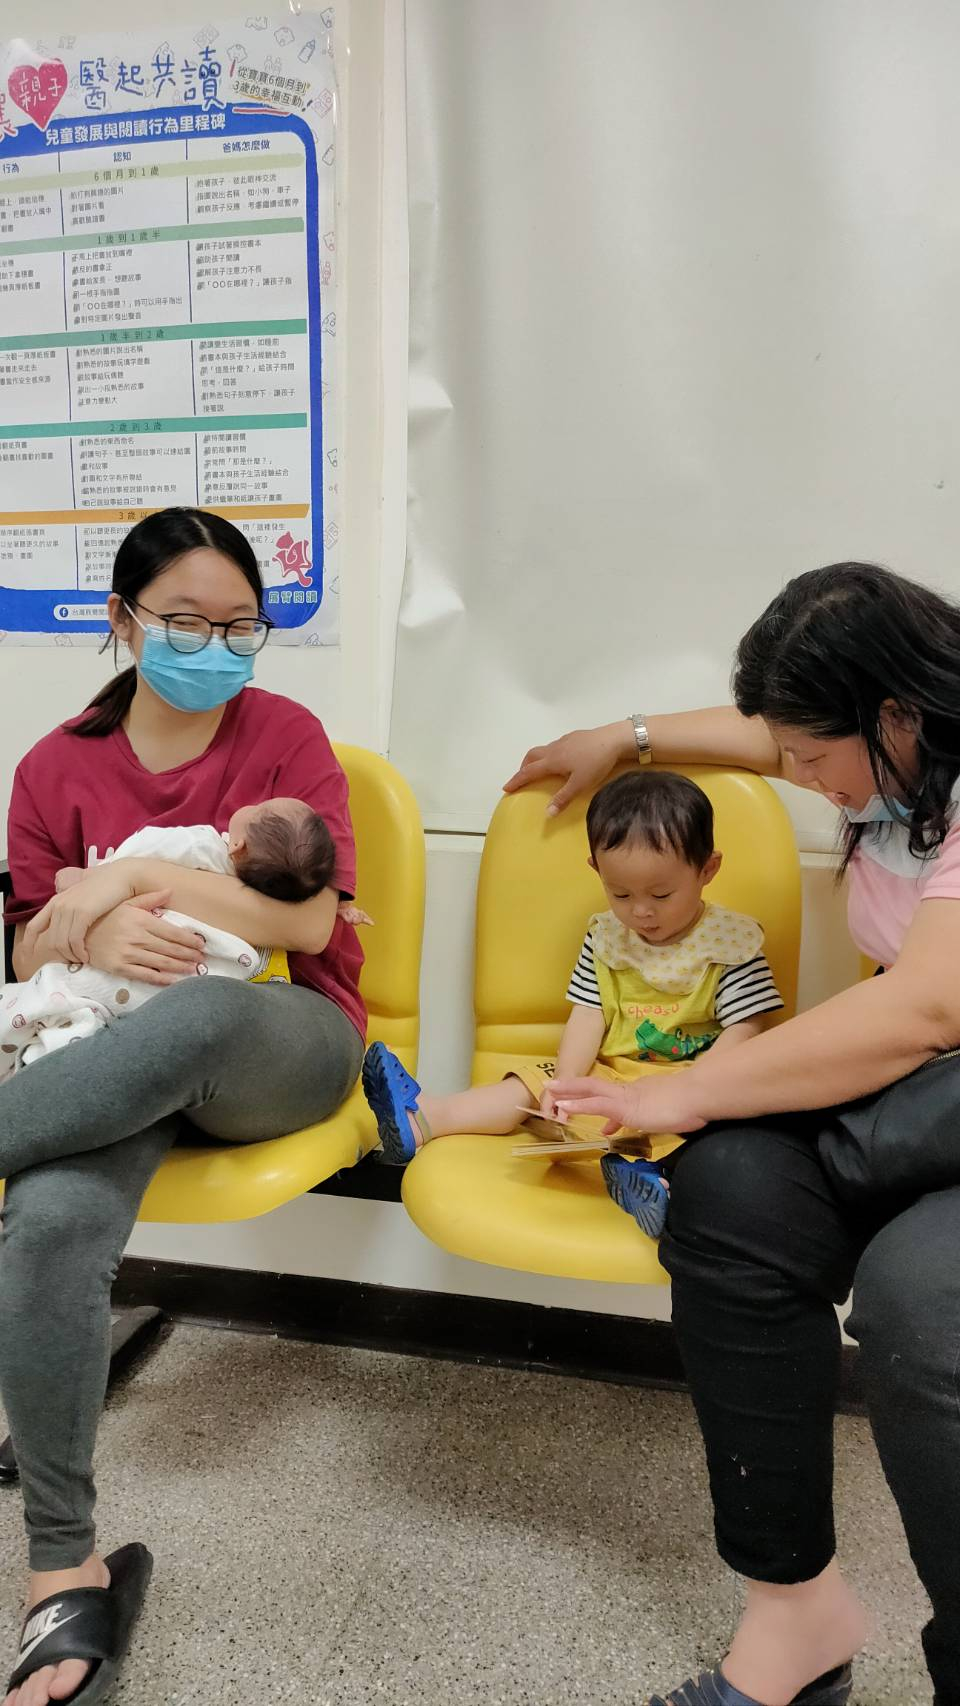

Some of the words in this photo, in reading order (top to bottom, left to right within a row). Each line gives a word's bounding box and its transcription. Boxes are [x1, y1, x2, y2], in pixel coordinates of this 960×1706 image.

[17, 72, 62, 111] 親子
[237, 66, 307, 95] 從寶寶6個月到
[45, 113, 226, 146] 兒童發展與閱讀行為里程碑
[113, 151, 131, 163] 認知
[222, 139, 271, 153] 爸媽怎麼做
[94, 166, 160, 181] 6個月到1歲
[110, 421, 162, 432] 2歲到3歲
[20, 1603, 64, 1648] NIKE
